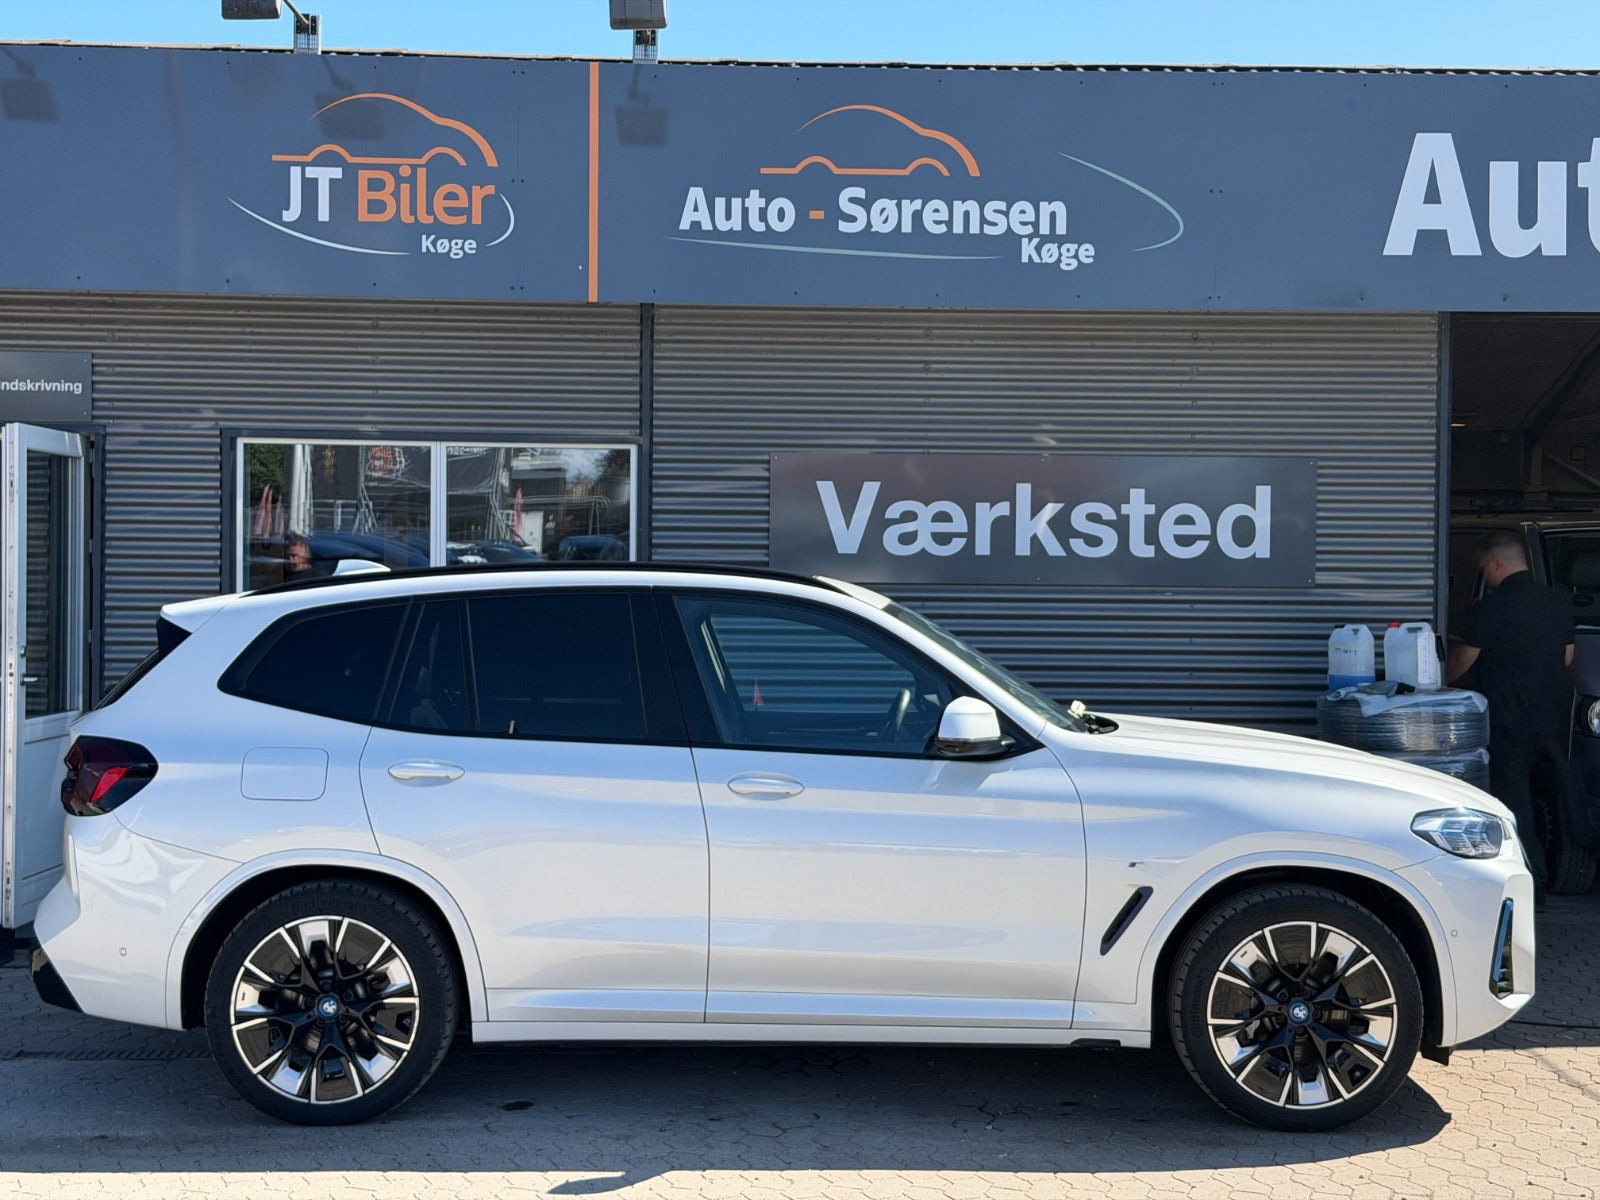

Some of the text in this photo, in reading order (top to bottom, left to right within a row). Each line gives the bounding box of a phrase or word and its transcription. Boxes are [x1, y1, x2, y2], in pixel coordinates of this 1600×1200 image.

[281, 164, 496, 225] JT Biler
[678, 186, 796, 232] Auto
[838, 186, 1067, 235] Sørensen
[421, 234, 477, 259] Køge
[1020, 237, 1095, 271] Køge
[0, 379, 83, 395] ndskrivning
[815, 480, 1272, 560] Værksted
